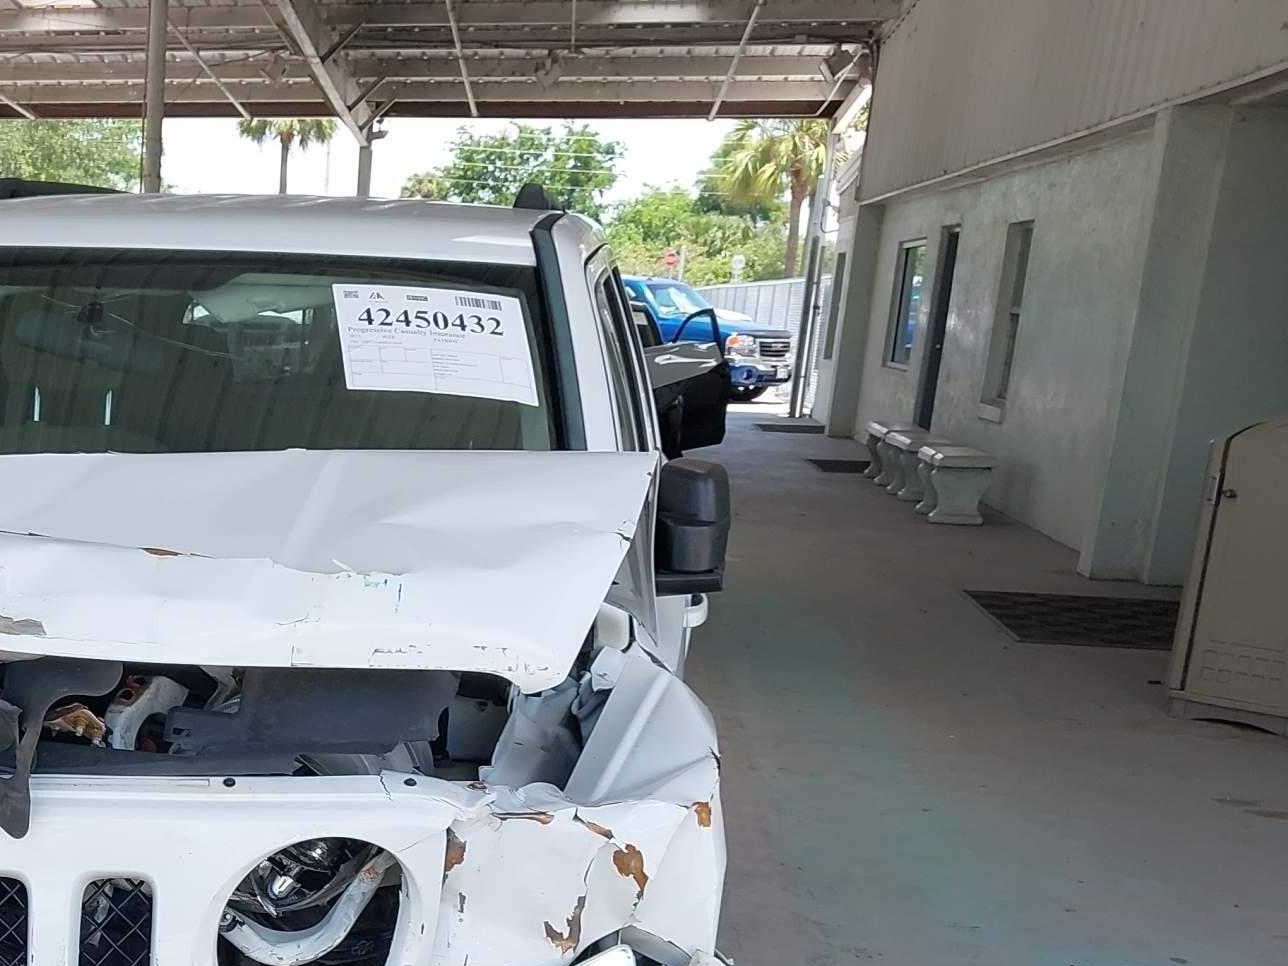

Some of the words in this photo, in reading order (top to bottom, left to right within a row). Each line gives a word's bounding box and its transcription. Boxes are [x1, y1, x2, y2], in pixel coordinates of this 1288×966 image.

[358, 307, 504, 336] 42450432
[347, 326, 393, 335] Progressive
[394, 328, 427, 336] Casualty
[429, 330, 466, 339] Insurance
